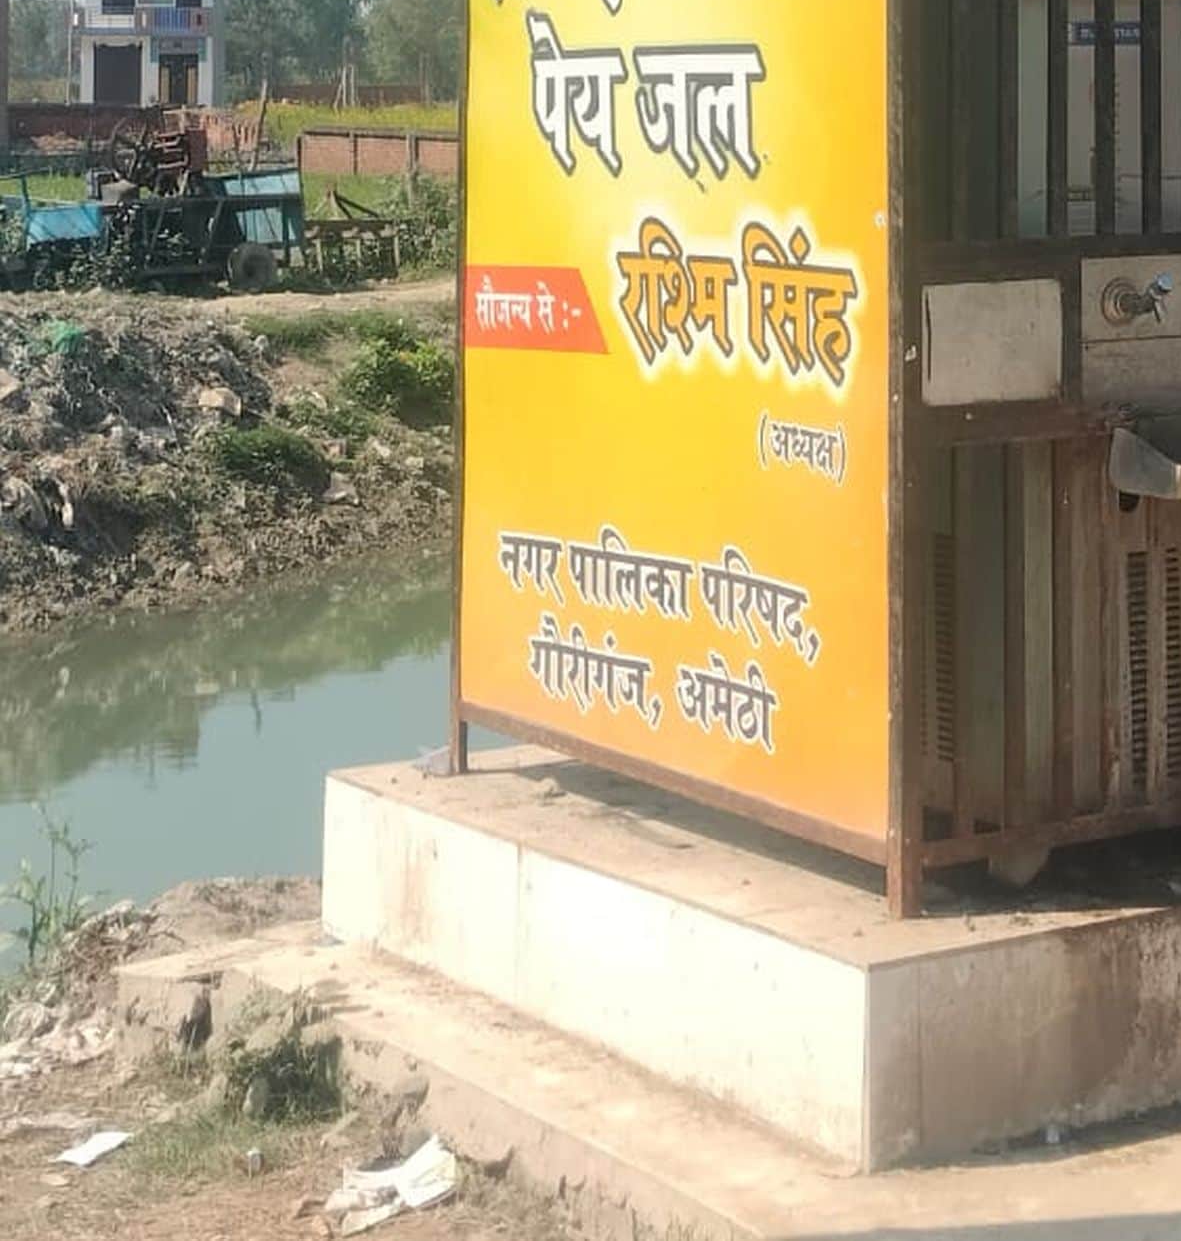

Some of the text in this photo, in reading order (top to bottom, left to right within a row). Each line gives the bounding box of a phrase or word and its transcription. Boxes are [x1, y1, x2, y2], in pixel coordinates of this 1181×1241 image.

[526, 9, 766, 180] पेय जल
[475, 274, 532, 332] सौजन्य
[536, 280, 555, 335] से
[616, 216, 859, 388] रश्मि सिंह
[760, 413, 846, 484] (अध्यक्ष)
[501, 535, 564, 601] नगर
[569, 529, 692, 617] पालिका
[679, 655, 777, 749] अमेठी
